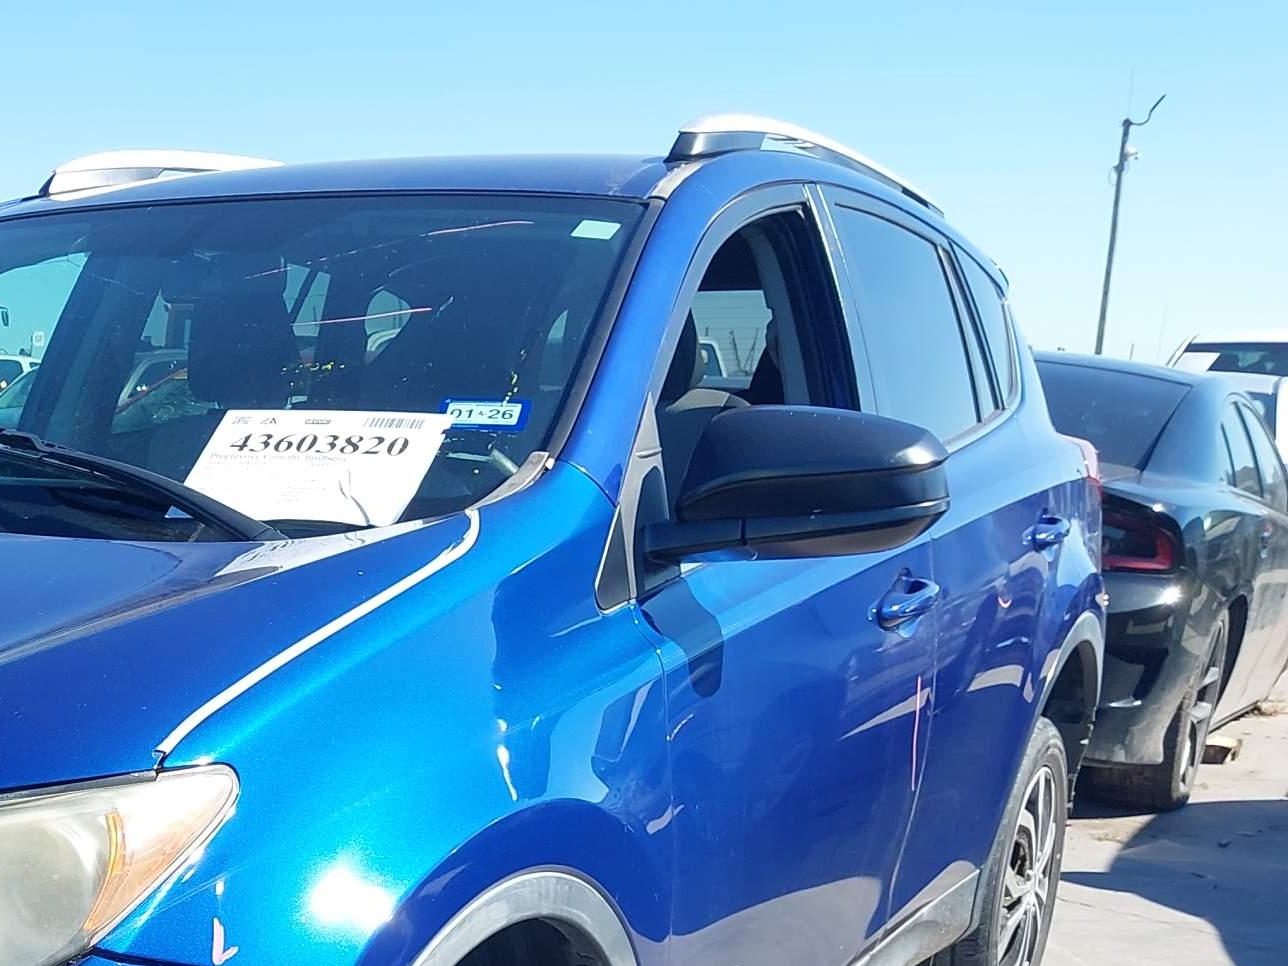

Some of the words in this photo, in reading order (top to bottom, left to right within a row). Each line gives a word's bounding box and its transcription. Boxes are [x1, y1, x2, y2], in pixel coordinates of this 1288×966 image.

[449, 408, 474, 419] 01
[487, 408, 514, 420] 26
[229, 433, 410, 456] 43603820
